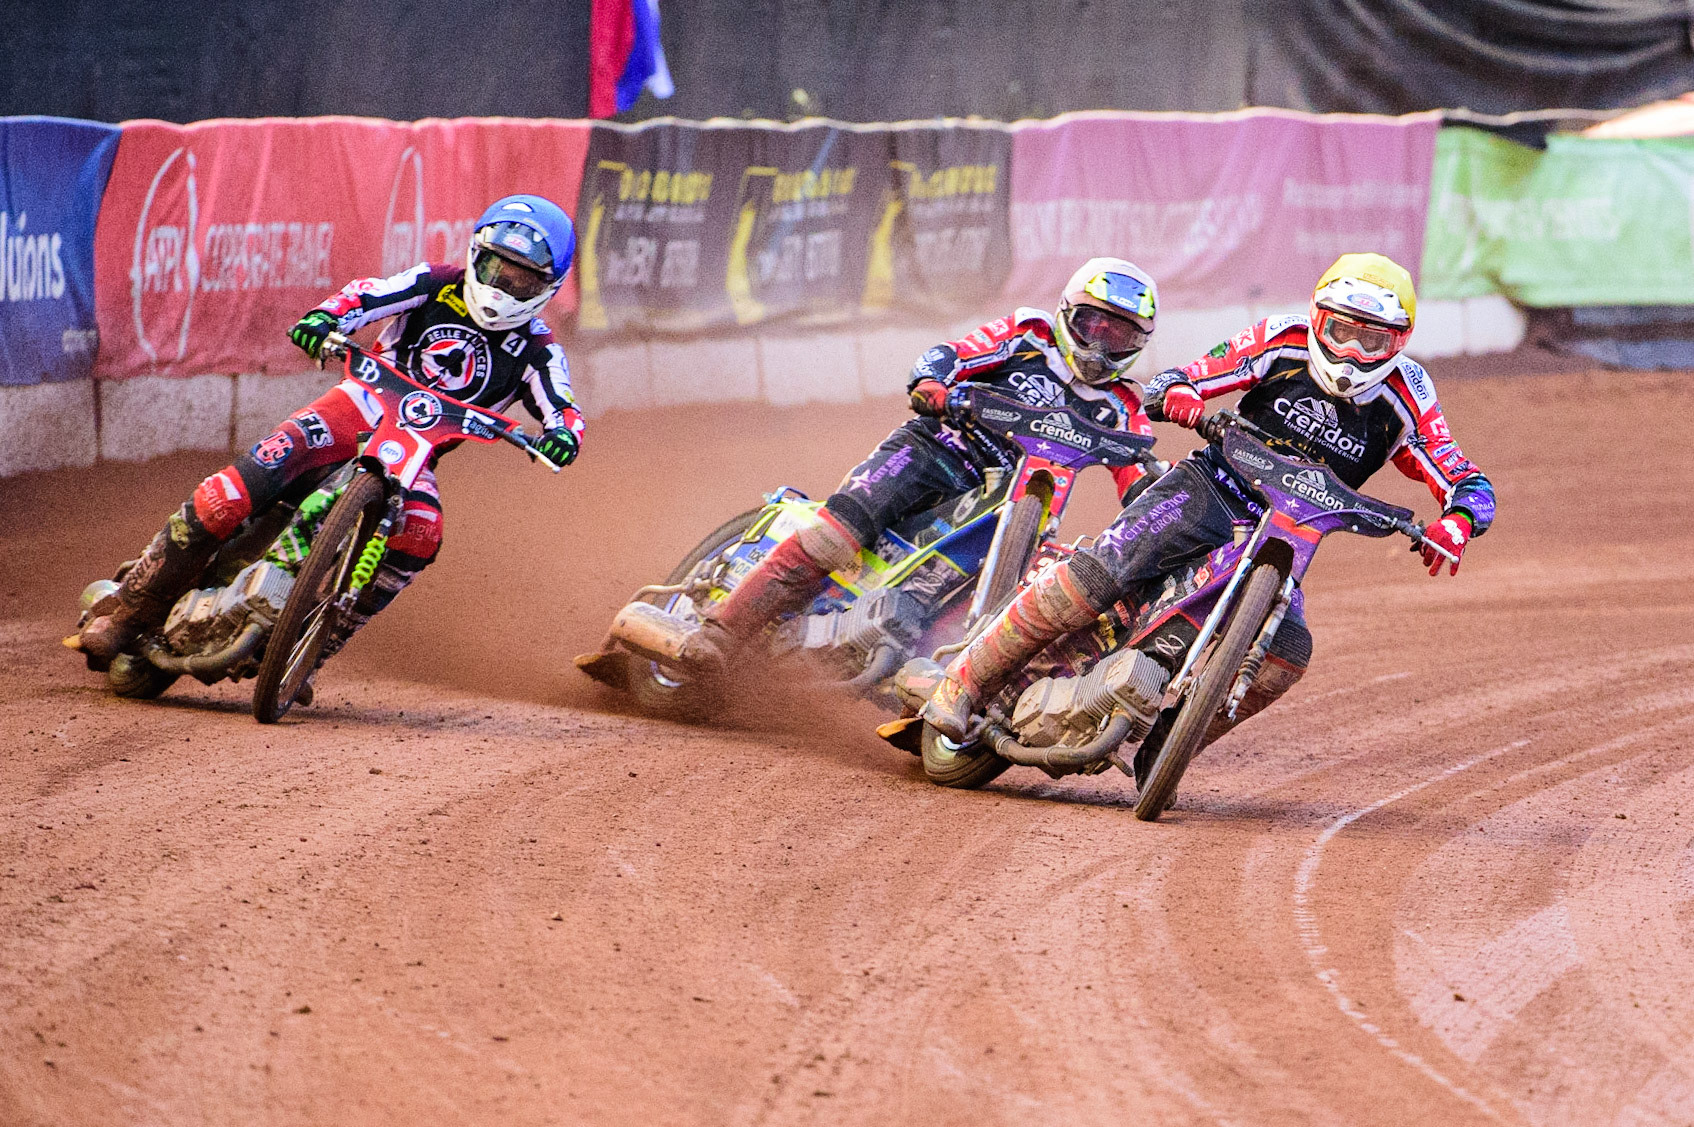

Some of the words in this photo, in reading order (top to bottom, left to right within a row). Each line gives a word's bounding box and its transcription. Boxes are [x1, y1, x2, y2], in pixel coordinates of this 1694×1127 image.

[427, 329, 461, 343] BELLE
[1404, 363, 1428, 400] endon
[1029, 419, 1093, 449] Crendon
[1273, 397, 1366, 458] Crendon
[1281, 472, 1345, 511] Crendon
[1124, 516, 1149, 540] CITY
[1149, 490, 1190, 520] AUCTION
[1150, 508, 1183, 534] GROUP
